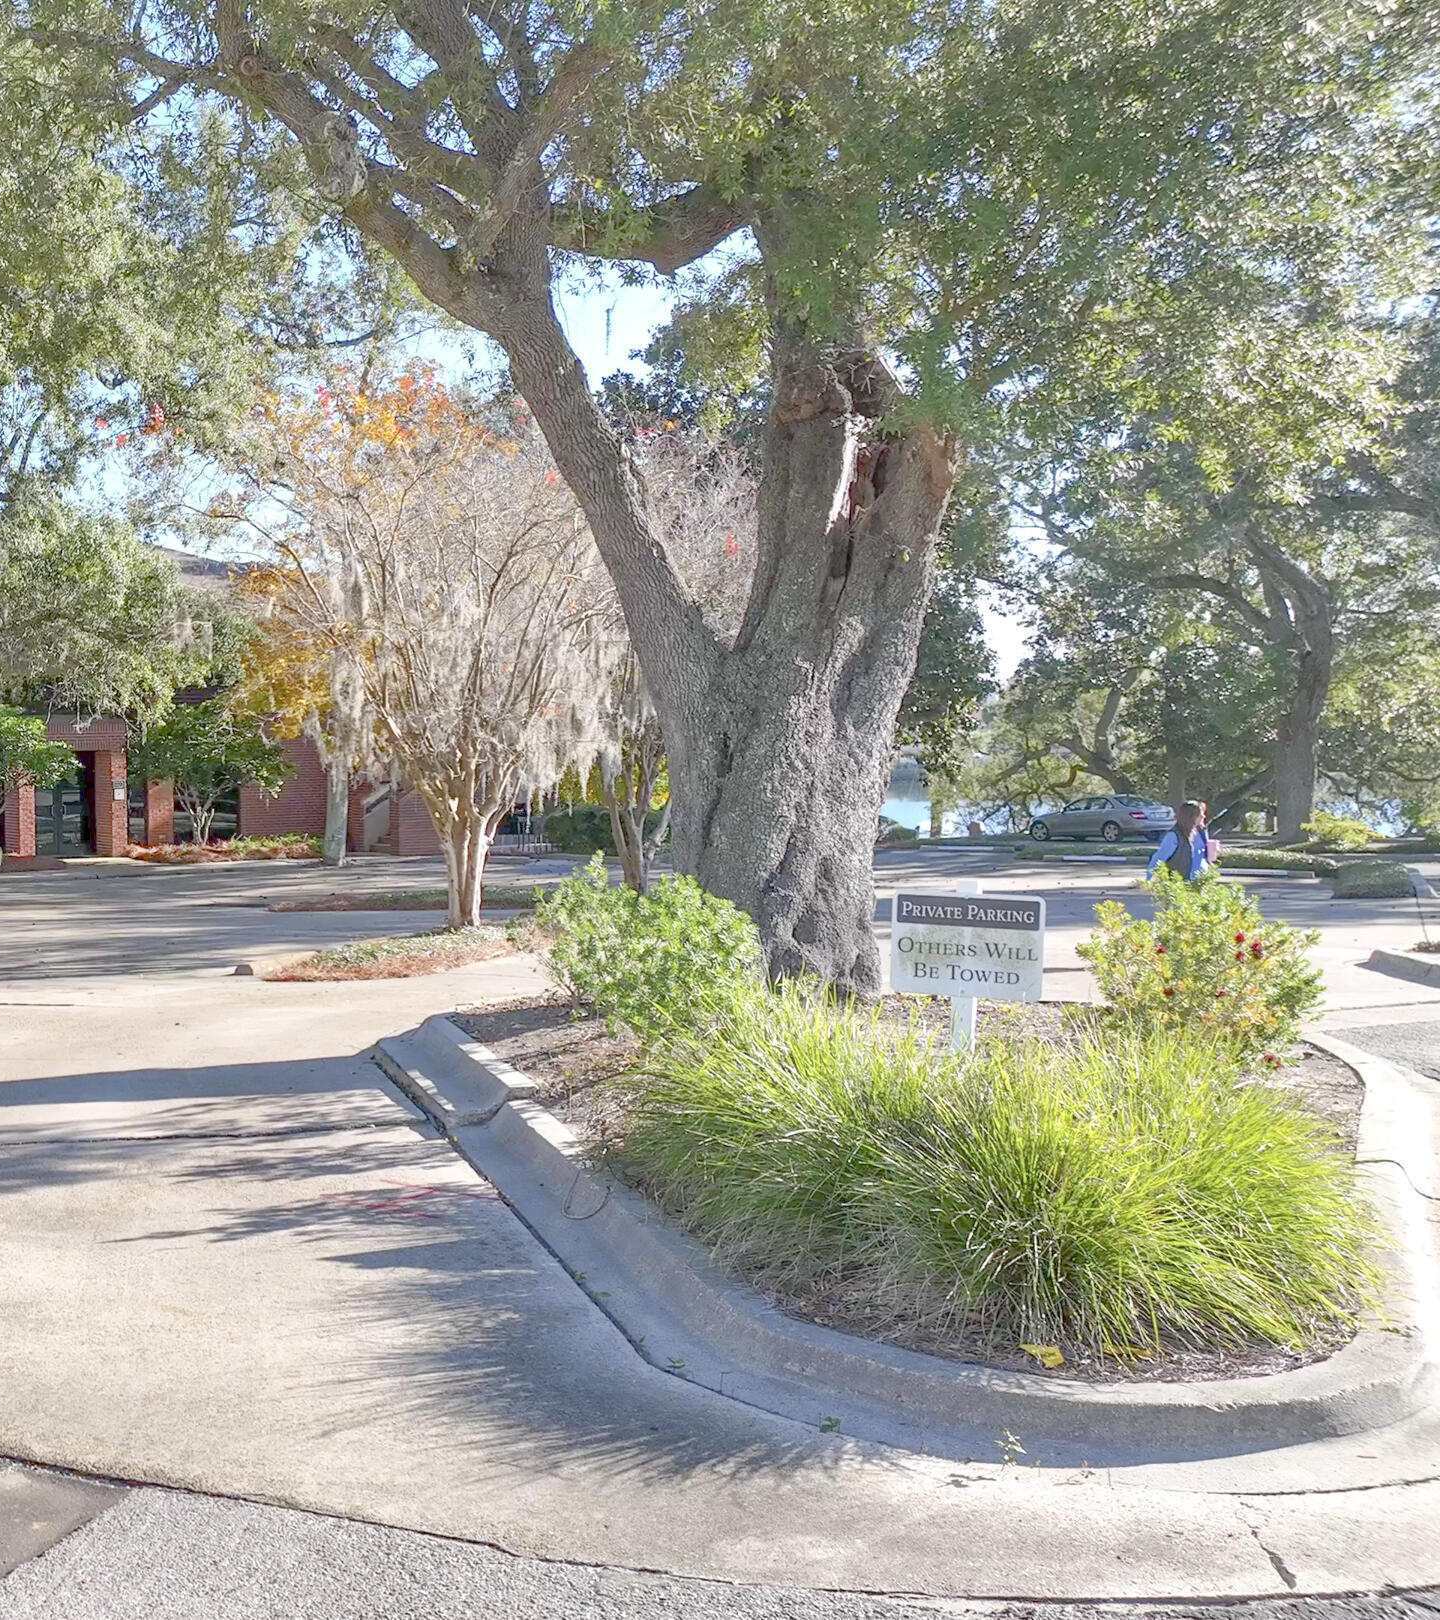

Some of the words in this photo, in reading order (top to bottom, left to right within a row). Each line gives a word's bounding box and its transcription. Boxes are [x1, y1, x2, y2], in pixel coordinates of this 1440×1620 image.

[902, 901, 962, 919] PRIVATE
[967, 904, 1035, 924] PARKING
[897, 936, 977, 958] OTHERS
[984, 942, 1038, 961] WILL
[913, 961, 940, 979] BE
[946, 964, 1020, 985] TOWED
